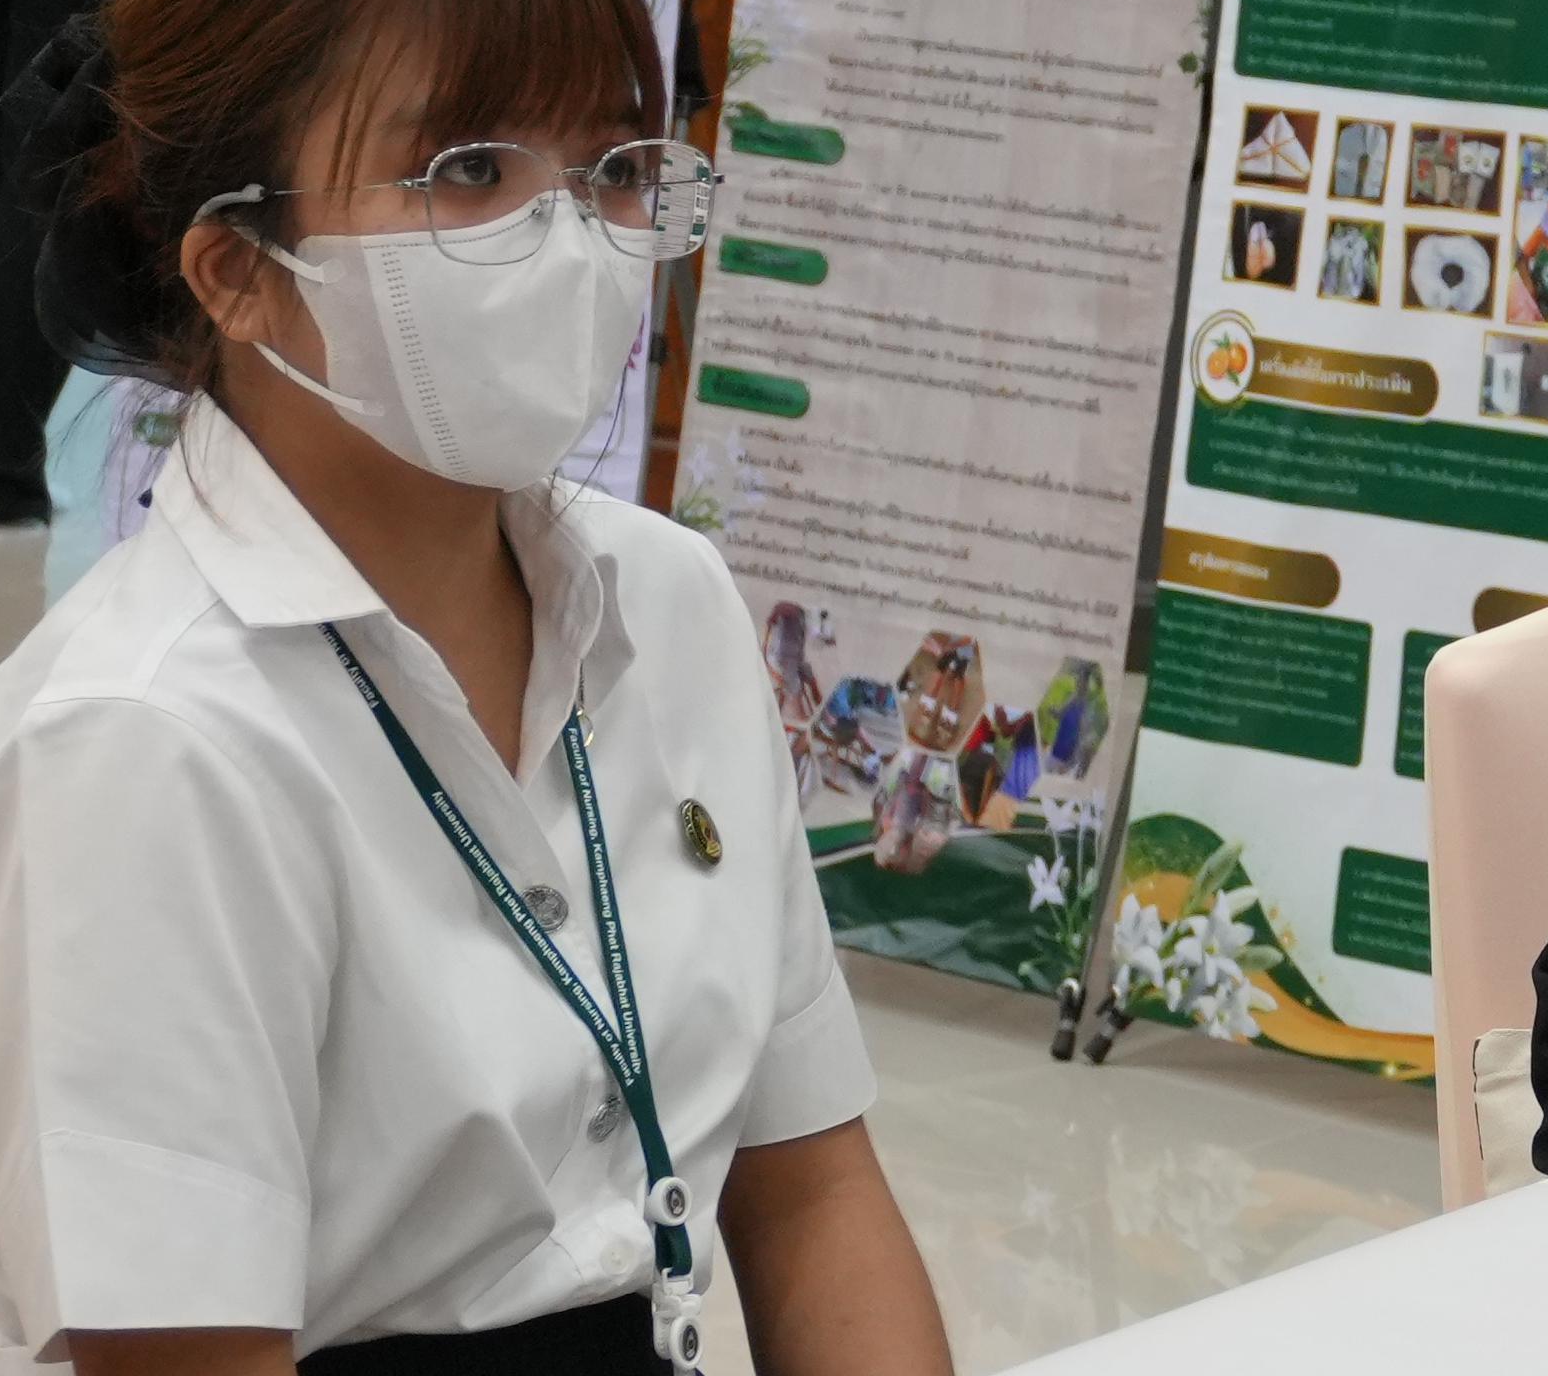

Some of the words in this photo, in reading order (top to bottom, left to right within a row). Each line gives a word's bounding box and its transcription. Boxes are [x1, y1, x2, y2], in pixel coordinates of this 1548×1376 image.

[431, 790, 473, 849] University
[468, 843, 509, 898] Rajabhat
[568, 726, 585, 771] Faculty
[579, 773, 590, 788] of
[592, 843, 613, 918] Kamphaeng
[610, 952, 631, 1008] Rajabhat
[503, 892, 527, 924] Phet
[523, 917, 574, 987] Kamphaeng
[601, 1028, 613, 1043] of
[609, 1043, 635, 1087] Faculty
